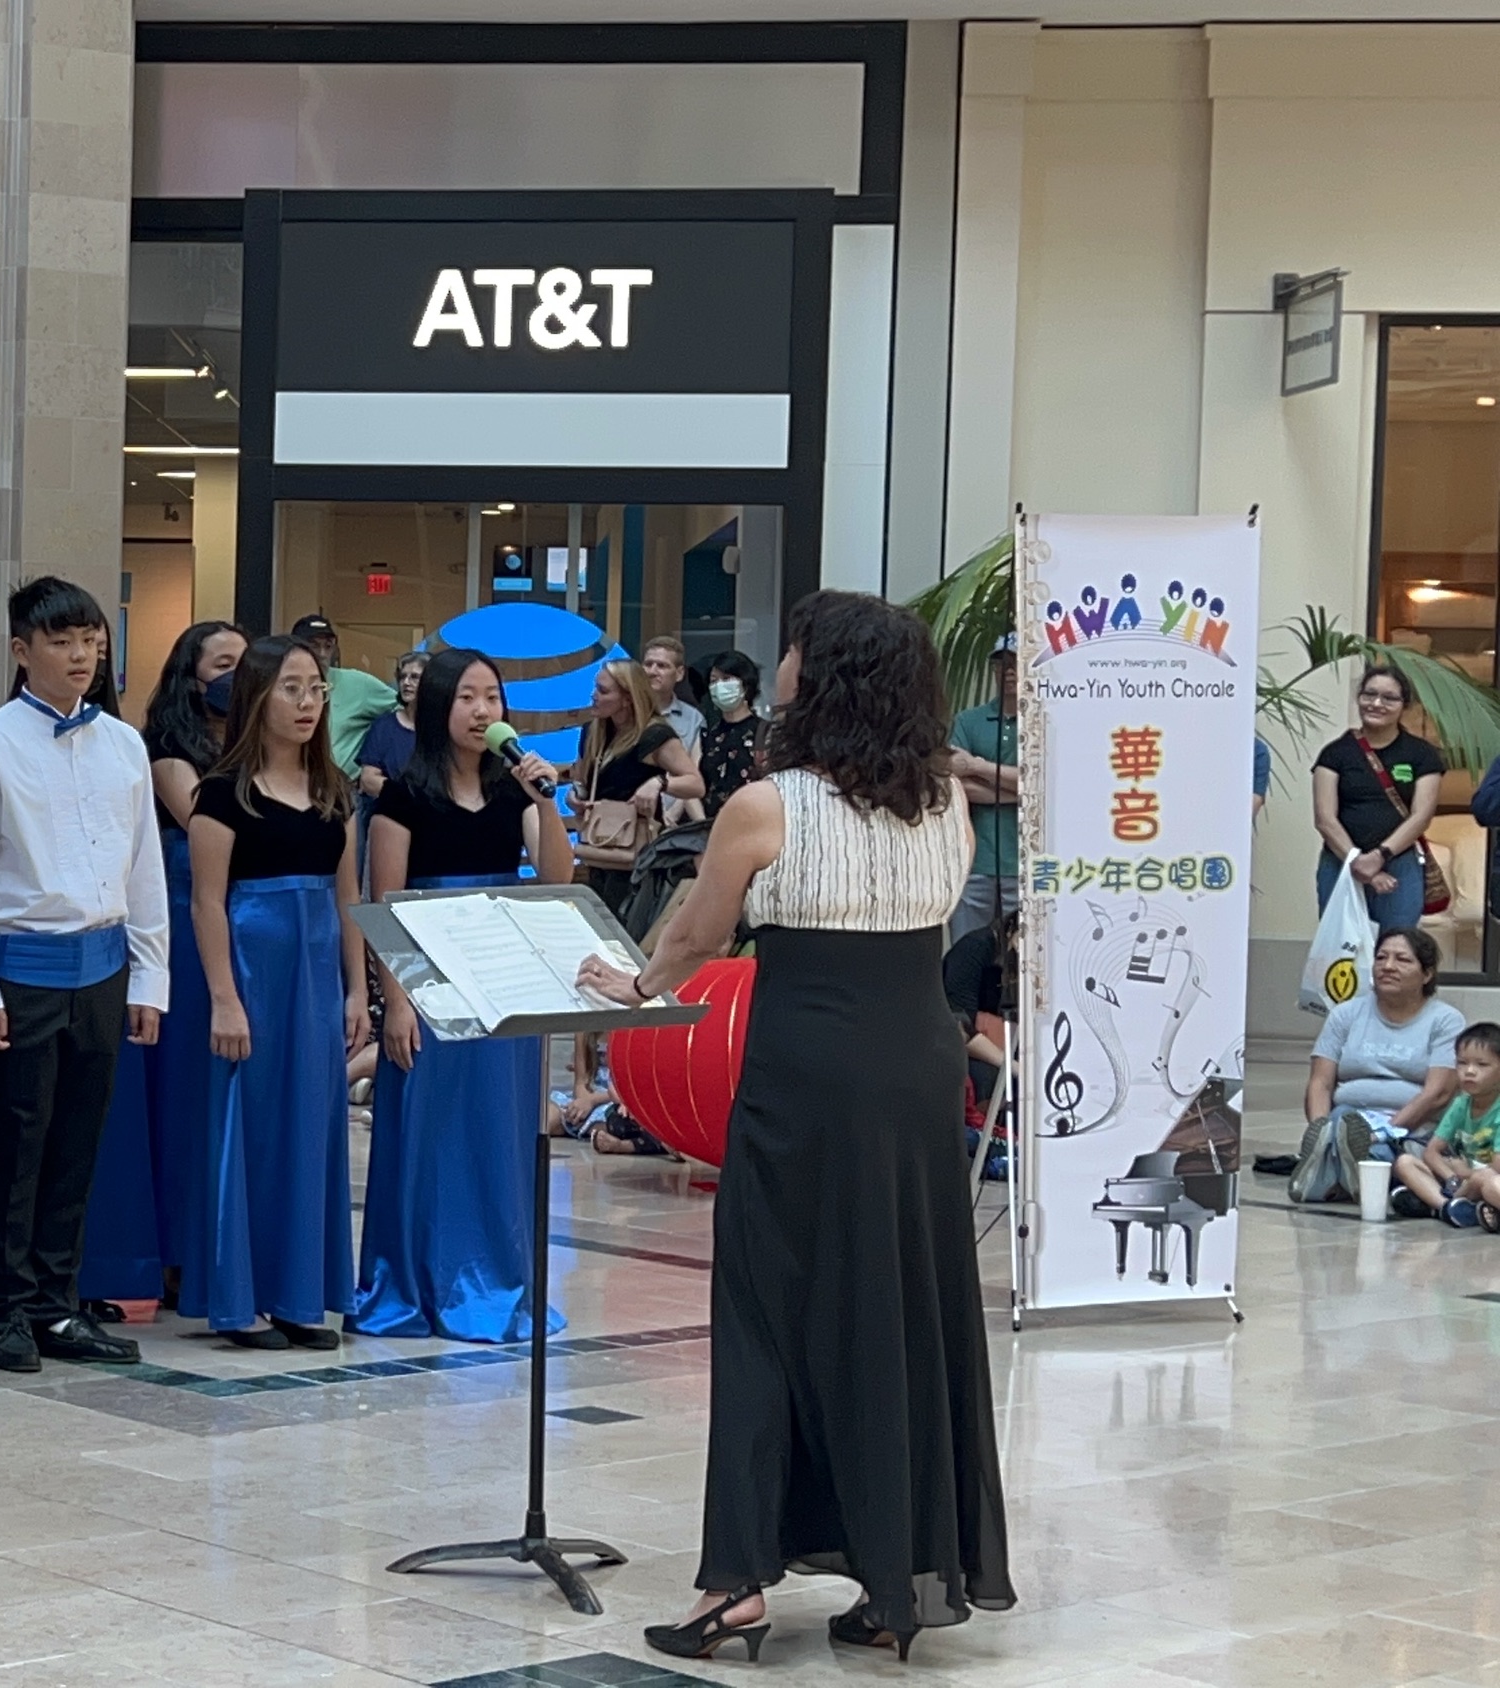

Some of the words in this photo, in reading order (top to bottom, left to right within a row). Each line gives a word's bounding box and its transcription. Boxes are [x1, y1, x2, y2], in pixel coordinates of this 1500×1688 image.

[411, 267, 654, 350] AT&T
[1045, 596, 1142, 656] HWA
[1159, 596, 1230, 656] YIN
[1037, 678, 1112, 699] Hwa-Yin
[1117, 679, 1166, 698] Youth
[1171, 677, 1235, 698] Chorale
[1088, 658, 1187, 670] www.hwa-yin.org
[1109, 726, 1162, 842] 華音
[1032, 856, 1233, 894] 青少年合唱團
